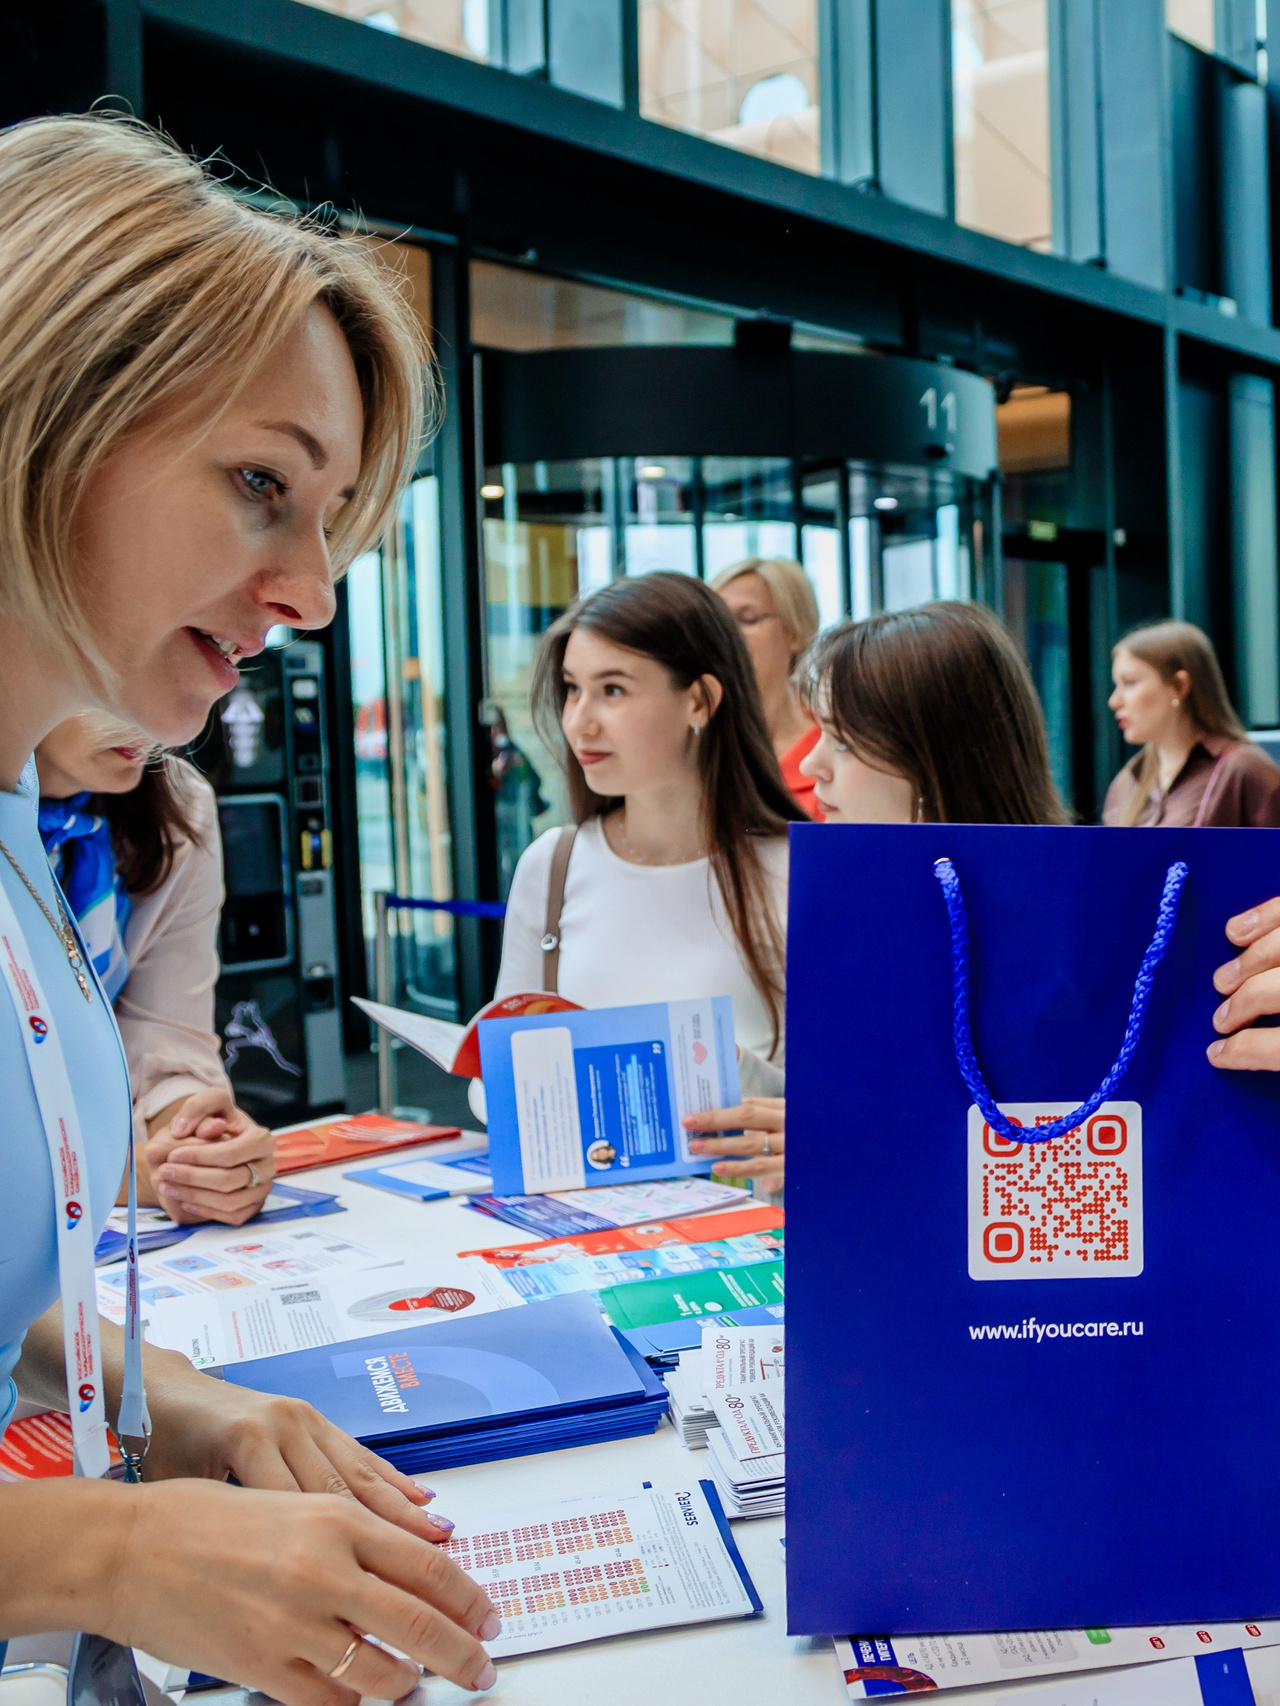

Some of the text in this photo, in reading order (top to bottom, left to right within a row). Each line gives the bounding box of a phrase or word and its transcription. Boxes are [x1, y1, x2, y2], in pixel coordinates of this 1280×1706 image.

[918, 387, 957, 432] 11
[716, 1338, 730, 1350] 80
[969, 1318, 1144, 1344] www.ifyoucare.ru
[364, 1356, 409, 1413] ДВИЖЕМСЯ
[388, 1351, 420, 1389] ВМЕСТЕ
[725, 1396, 744, 1409] 80
[677, 1491, 699, 1526] SERVIER
